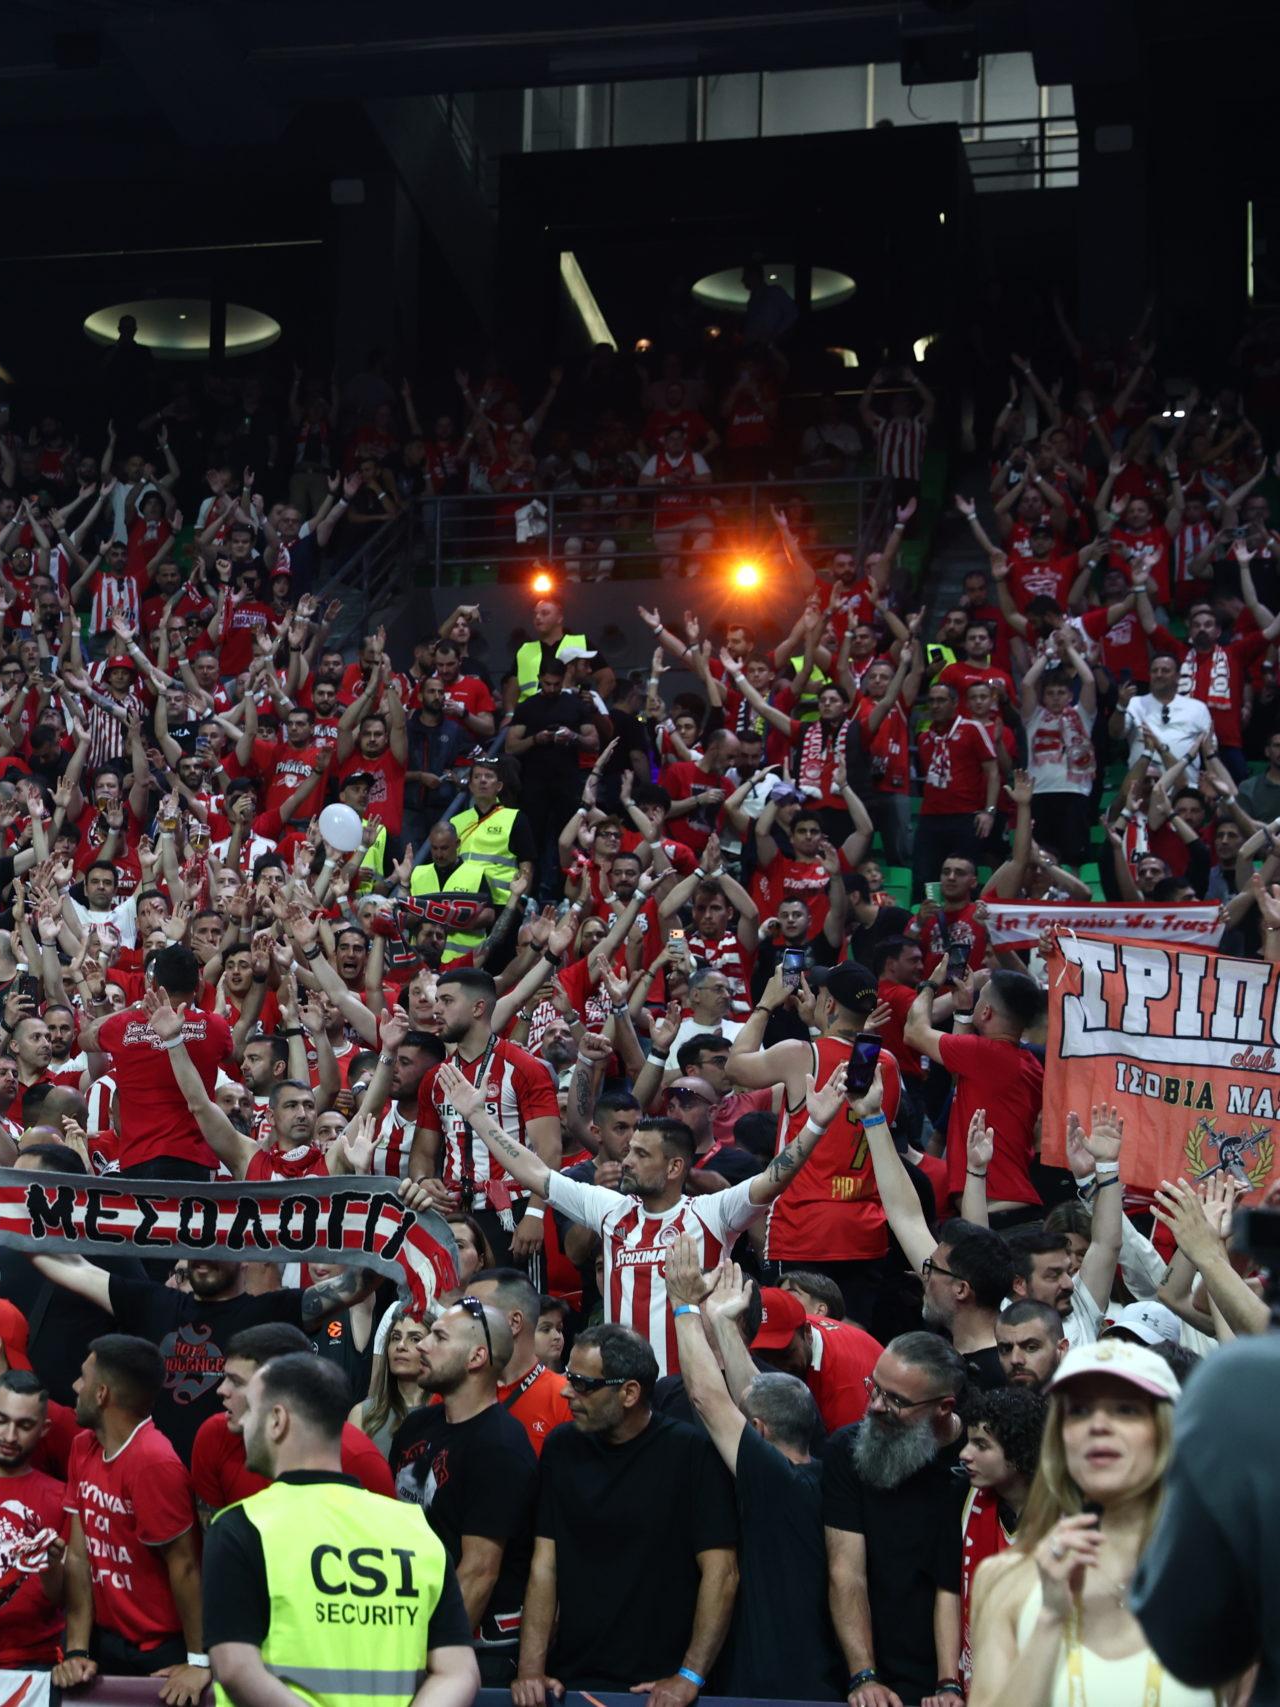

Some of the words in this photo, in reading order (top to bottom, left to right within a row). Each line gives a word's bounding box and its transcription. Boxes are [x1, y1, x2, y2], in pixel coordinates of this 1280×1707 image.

[995, 913, 1019, 932] In
[1058, 936, 1280, 1047] ΤΡΙΠ
[1230, 1046, 1276, 1071] club
[1115, 1062, 1215, 1112] ΙΣΟΒΙΑ
[615, 1248, 668, 1271] STOIXIMA
[311, 1544, 419, 1597] CSI
[316, 1602, 419, 1626] SECURITY
